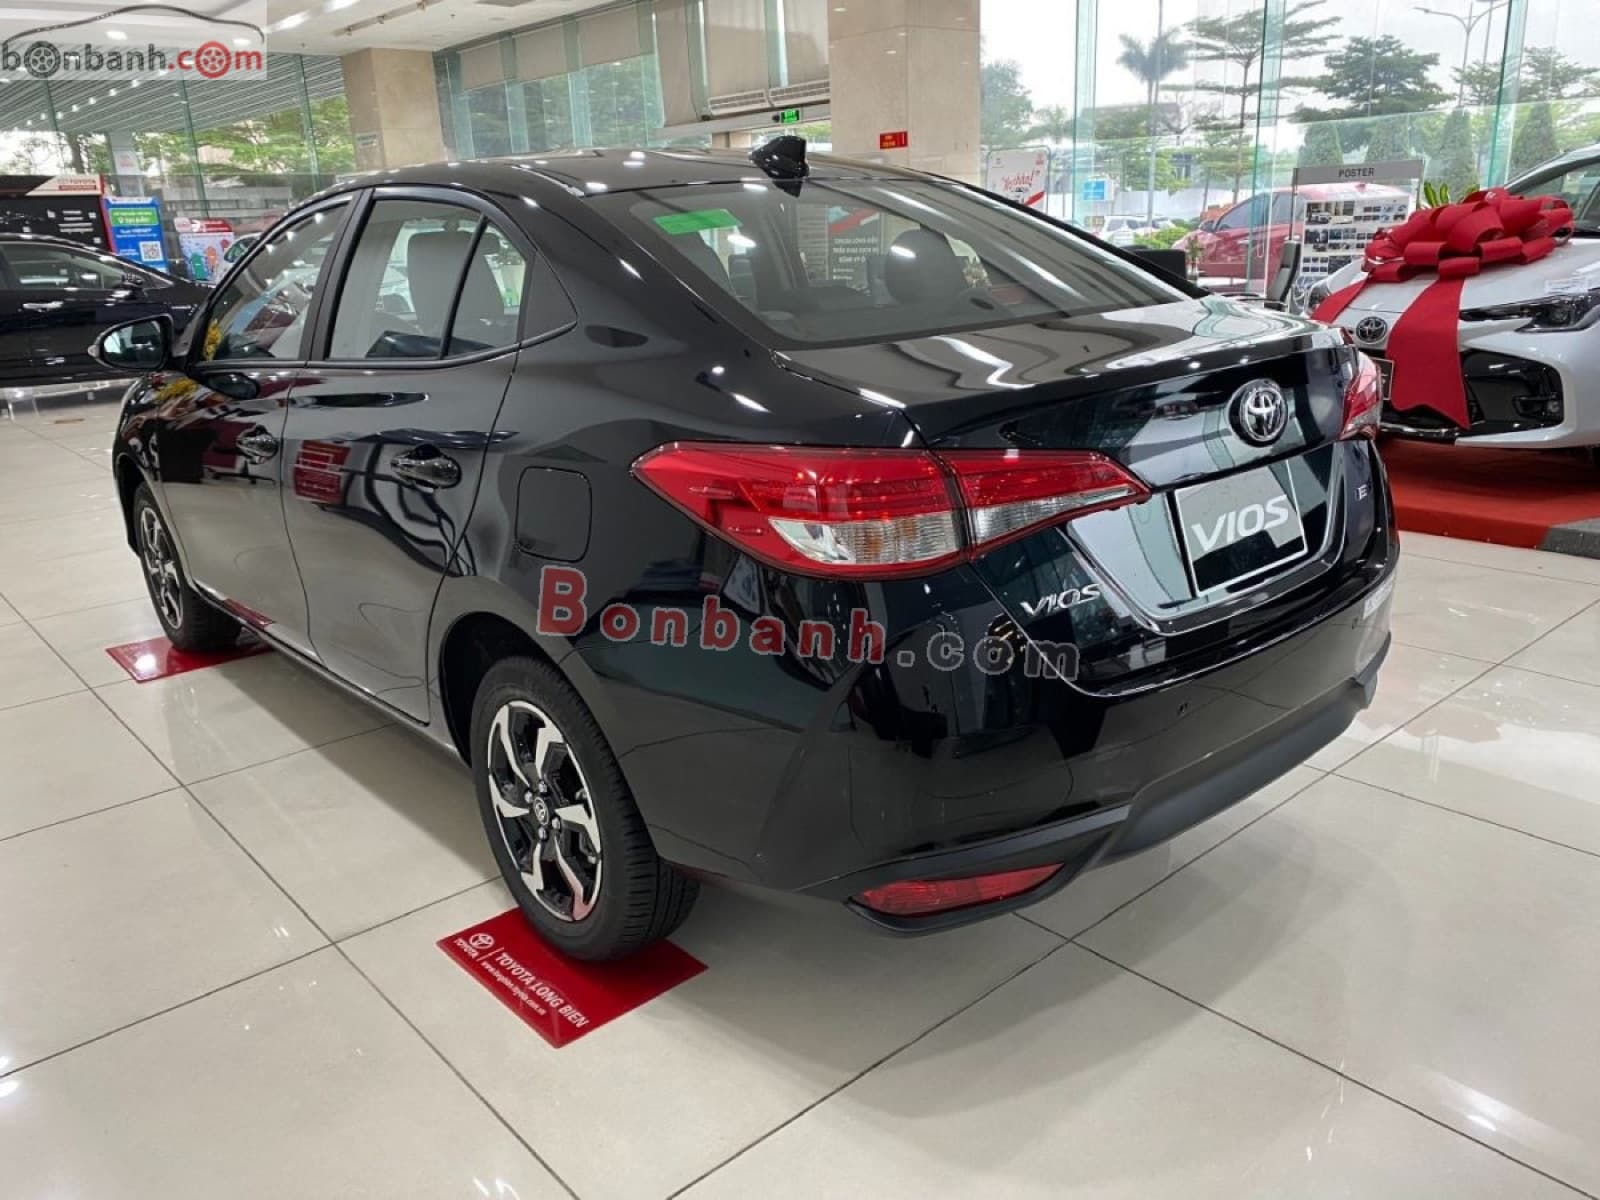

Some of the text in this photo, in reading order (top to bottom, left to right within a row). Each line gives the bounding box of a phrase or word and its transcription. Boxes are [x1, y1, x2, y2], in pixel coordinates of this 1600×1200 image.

[1338, 166, 1375, 179] POSTER
[1190, 494, 1289, 552] VIOS
[1019, 582, 1101, 616] VIOS
[453, 937, 479, 959] TOYOTA
[496, 952, 590, 1028] TOYOTA LONG BIEN
